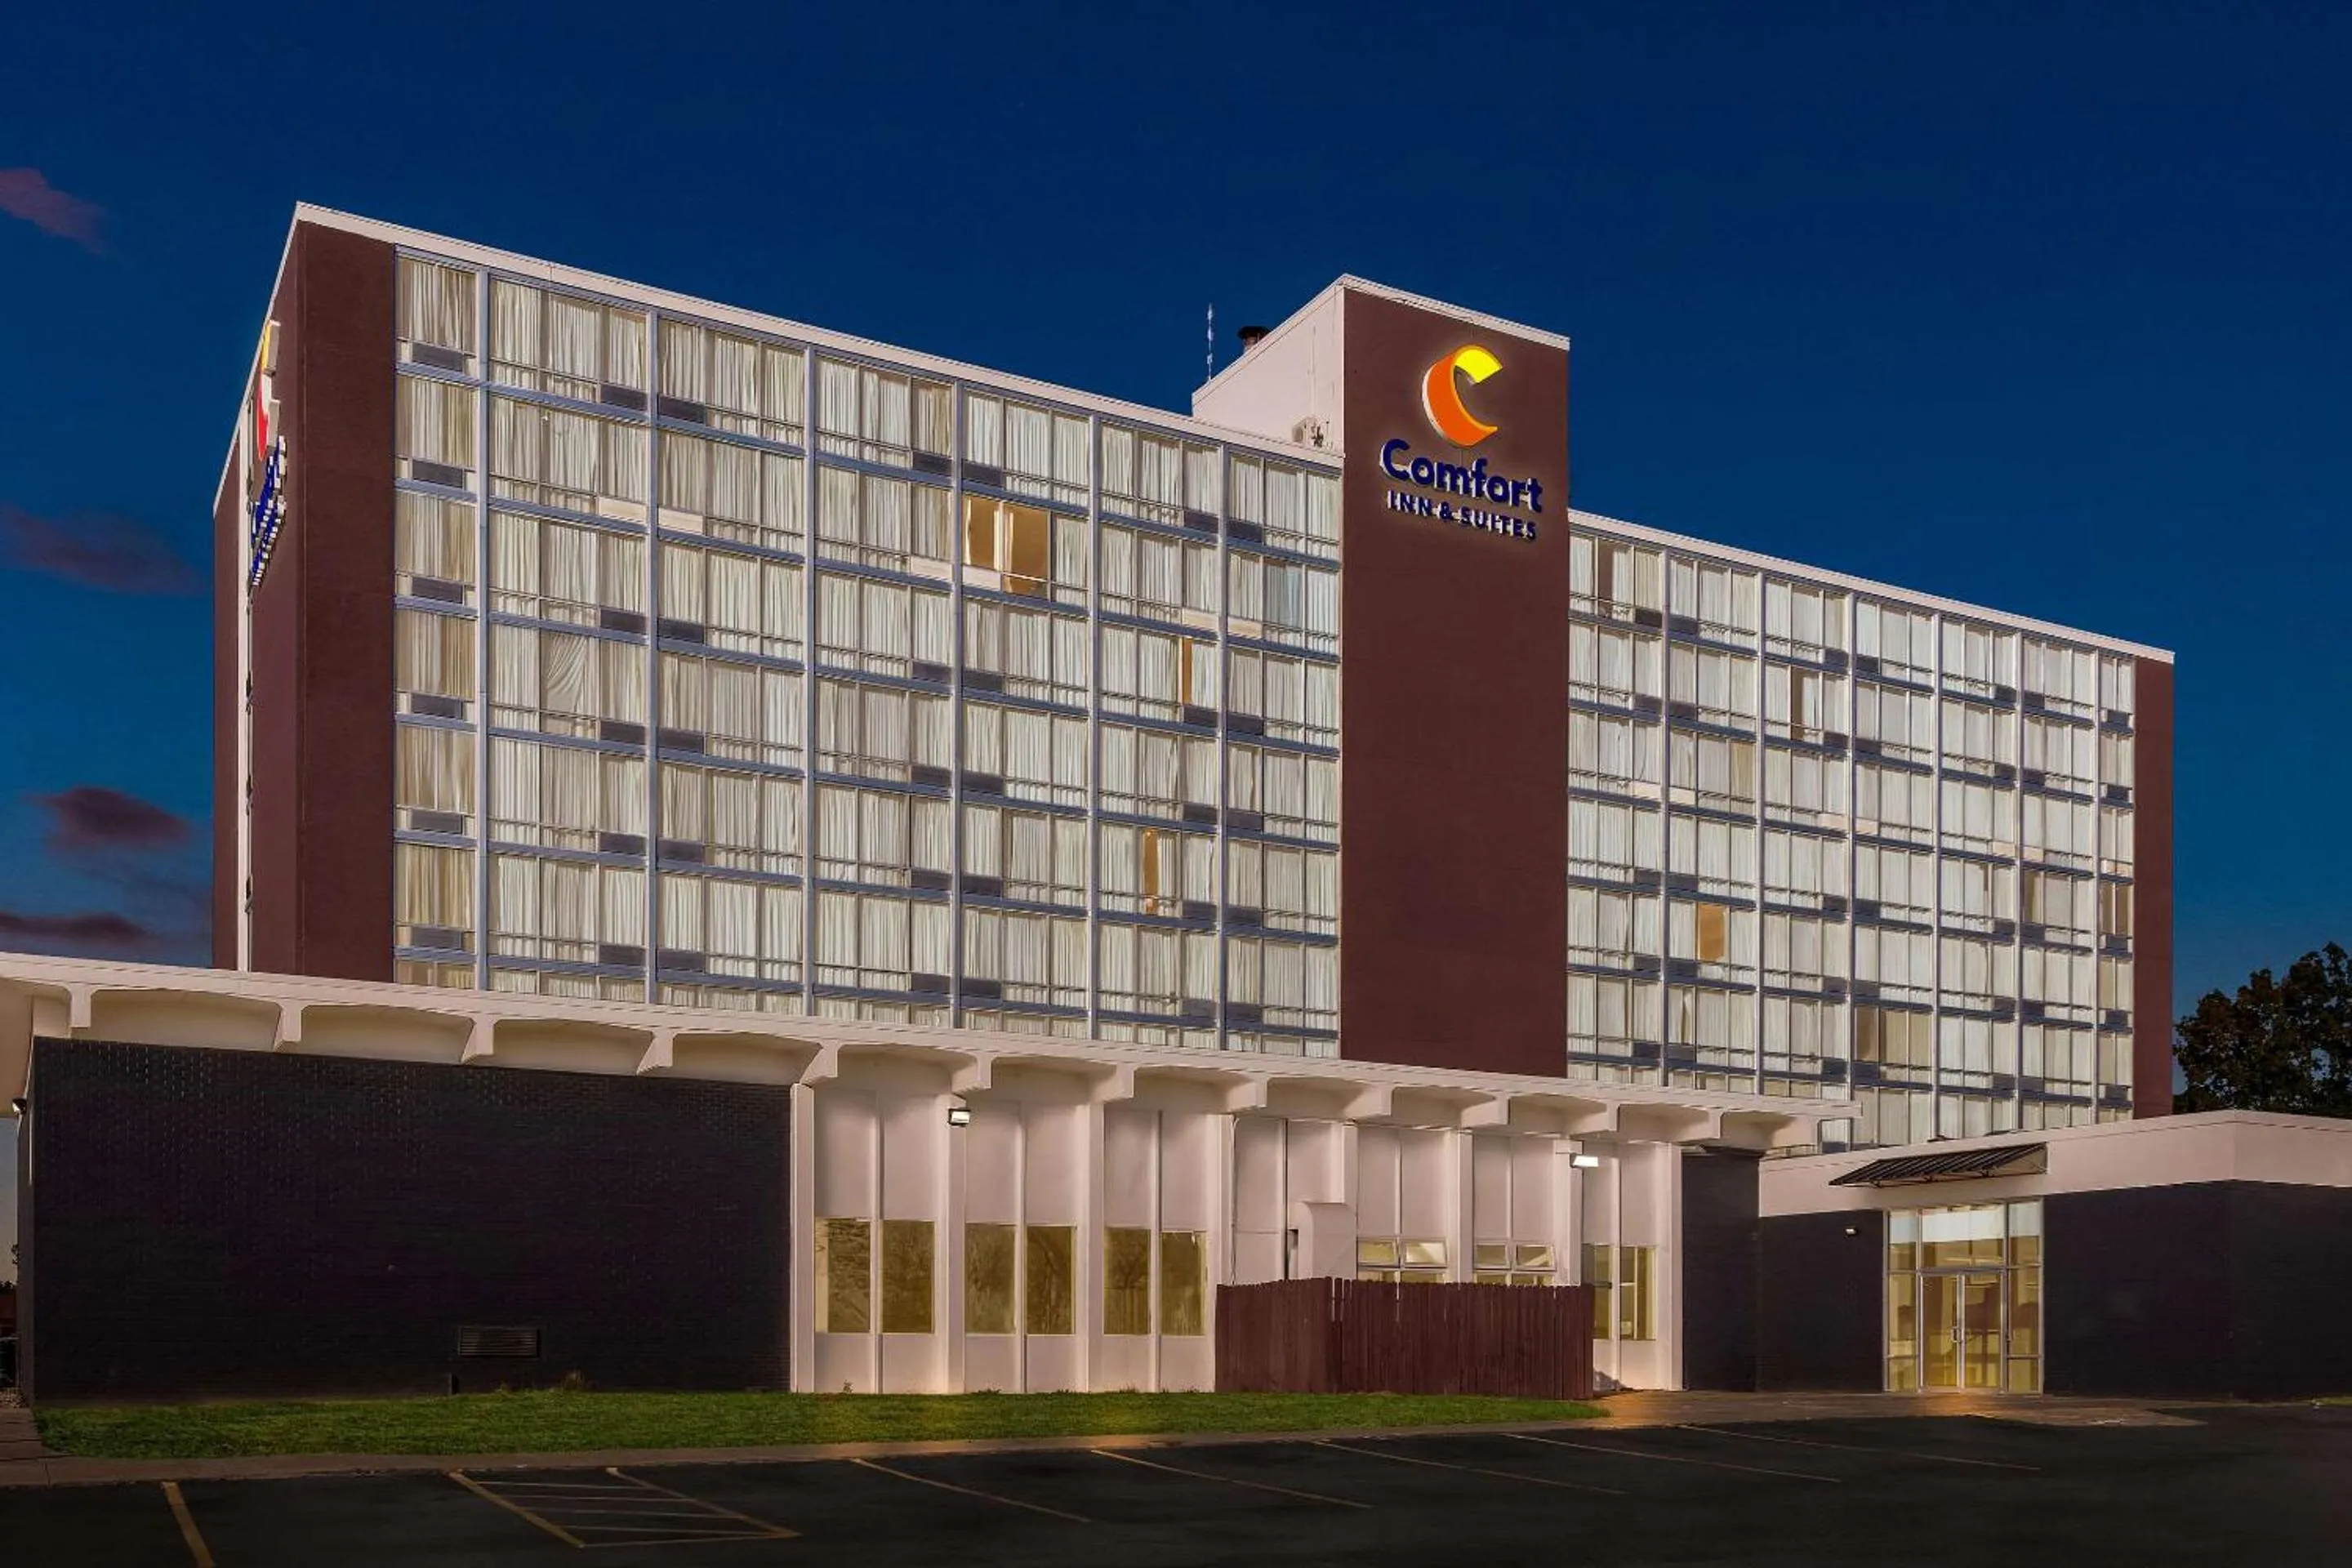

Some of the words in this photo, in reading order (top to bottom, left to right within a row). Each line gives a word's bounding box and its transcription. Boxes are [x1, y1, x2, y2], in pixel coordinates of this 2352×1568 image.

[1379, 439, 1543, 513] Comfort
[1388, 490, 1432, 517] INN
[1435, 501, 1453, 520] &
[1458, 506, 1537, 541] SUITES
